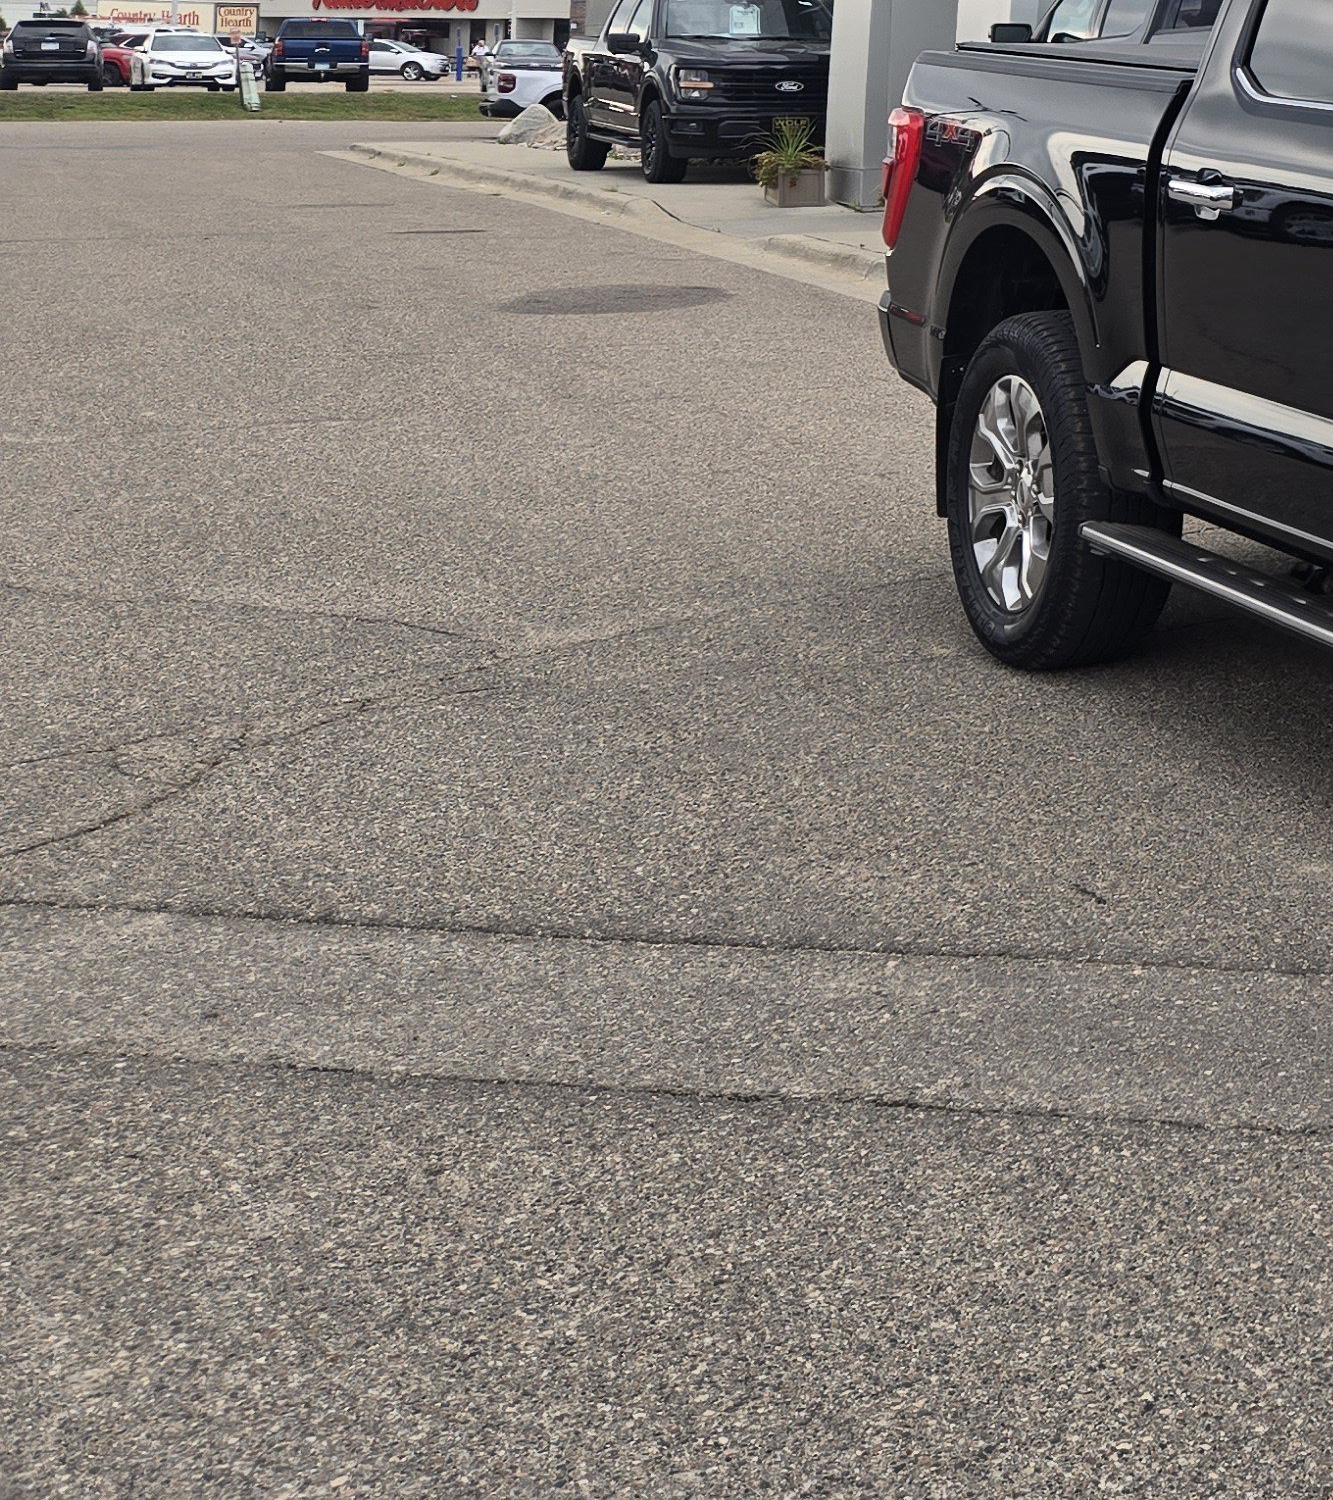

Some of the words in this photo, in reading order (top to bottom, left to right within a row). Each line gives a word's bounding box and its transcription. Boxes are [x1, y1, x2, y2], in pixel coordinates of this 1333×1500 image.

[162, 10, 199, 25] Harth
[218, 6, 254, 18] Country
[221, 17, 252, 27] Hearth
